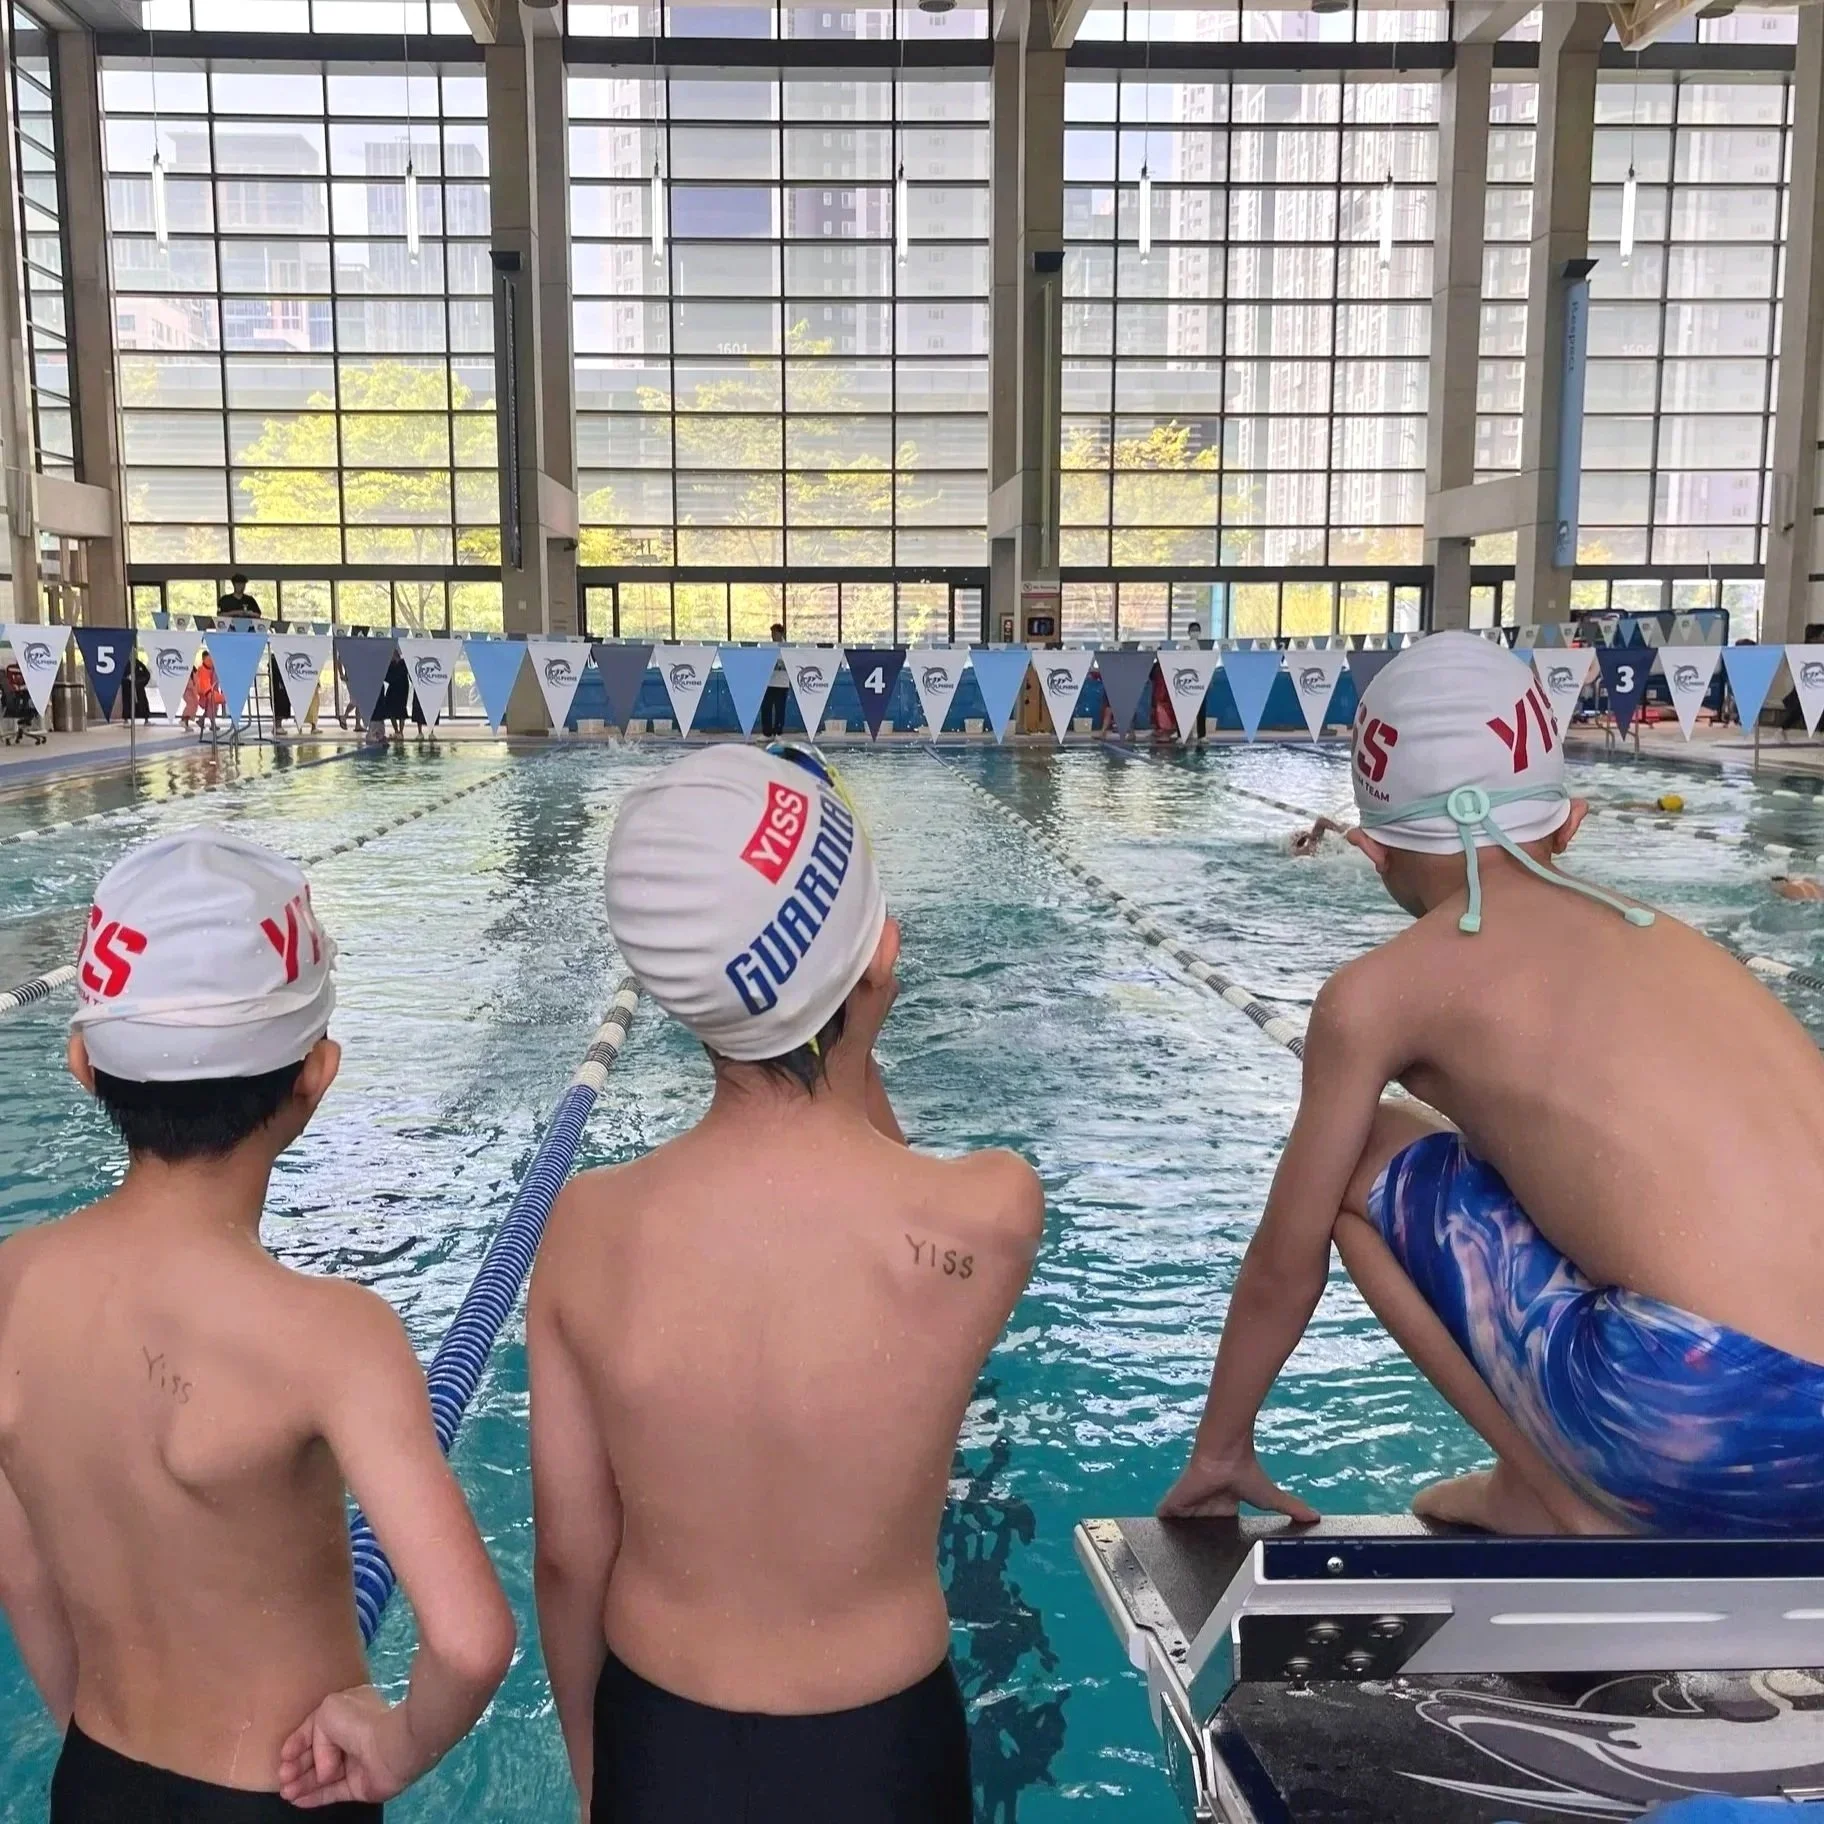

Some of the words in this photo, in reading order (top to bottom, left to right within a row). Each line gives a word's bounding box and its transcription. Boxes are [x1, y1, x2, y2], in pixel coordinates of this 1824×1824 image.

[716, 342, 748, 354] 1601
[96, 646, 116, 674] 5
[864, 666, 886, 694] 4
[1616, 666, 1634, 693] 3
[1365, 781, 1390, 802] TEAM
[750, 788, 803, 867] YISS
[725, 784, 854, 1016] GUARDIA
[905, 1233, 975, 1280] YISS
